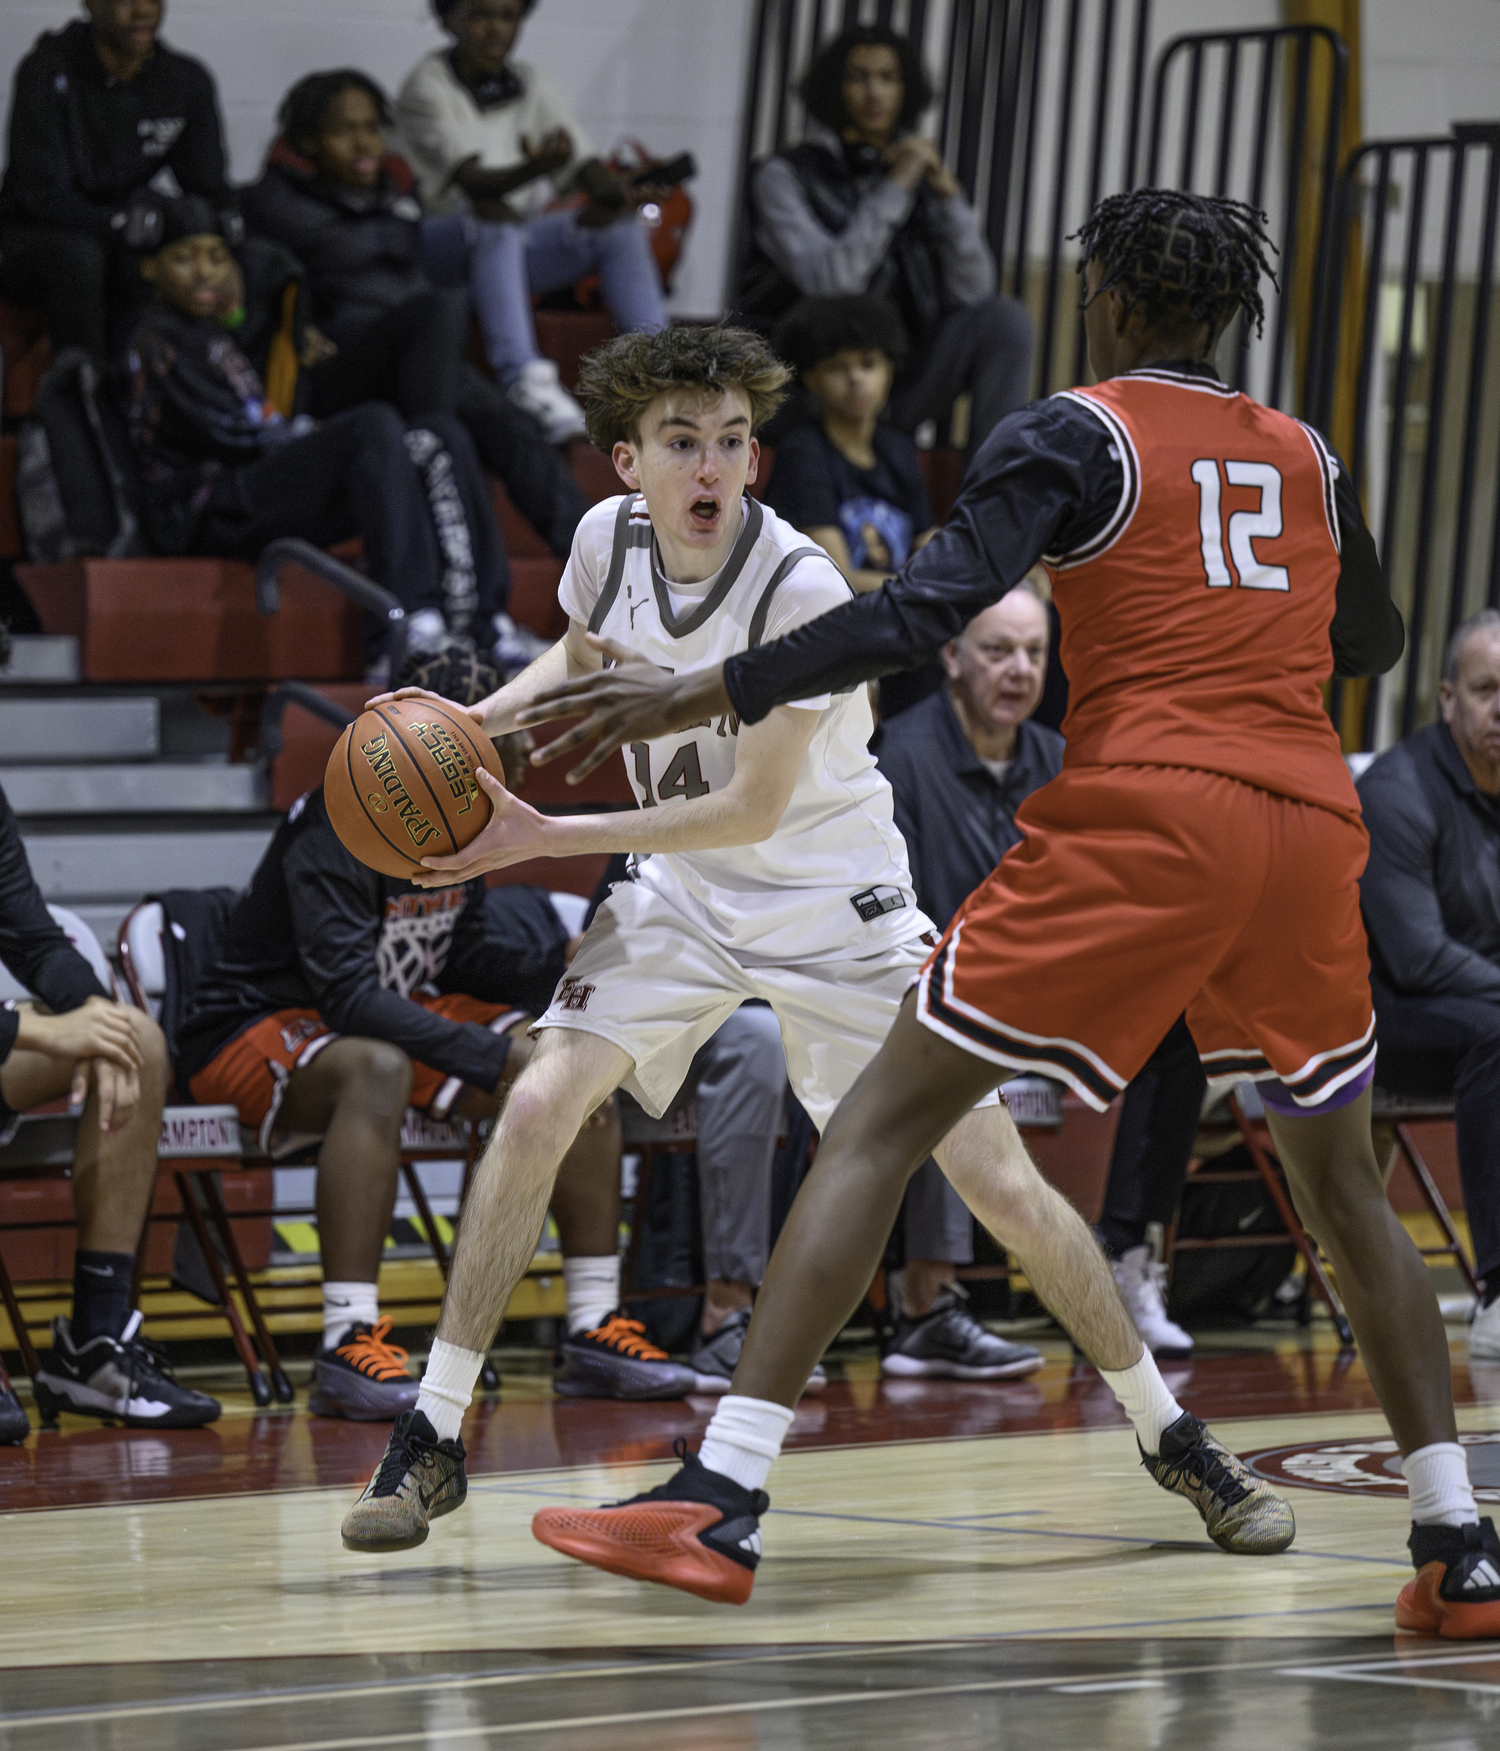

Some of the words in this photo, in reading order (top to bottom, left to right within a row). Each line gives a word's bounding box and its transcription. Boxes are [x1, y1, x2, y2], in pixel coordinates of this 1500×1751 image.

[1191, 459, 1290, 592] 12
[360, 732, 442, 847] SPALDING
[407, 722, 472, 816] LEGACY
[630, 741, 710, 808] 14
[161, 1119, 229, 1147] AMPTON
